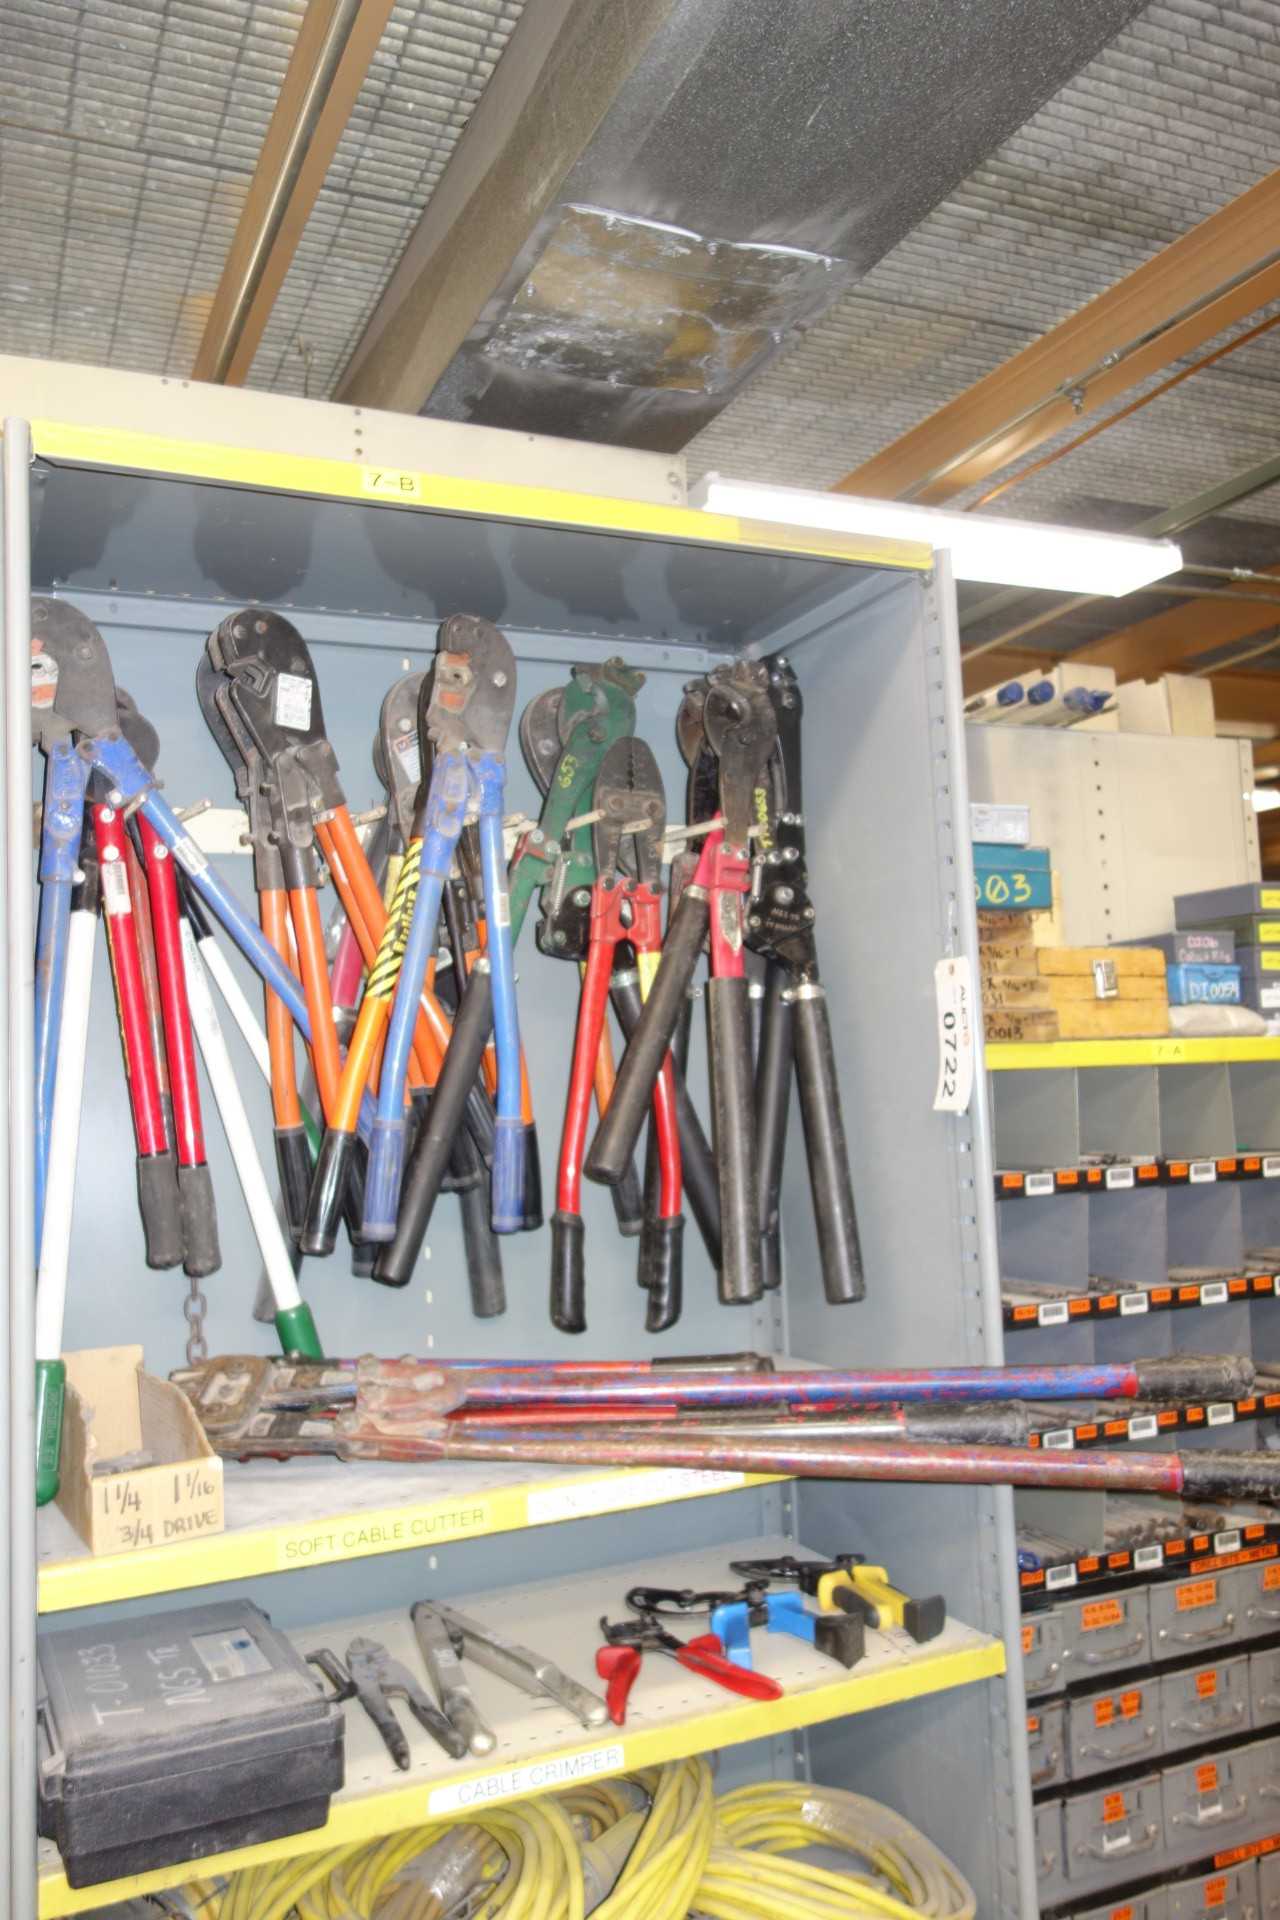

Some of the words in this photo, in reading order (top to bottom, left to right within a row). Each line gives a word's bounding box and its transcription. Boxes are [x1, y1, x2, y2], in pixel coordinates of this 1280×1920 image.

[368, 472, 415, 492] 7-B
[942, 1011, 958, 1098] 0722
[163, 1509, 217, 1538] DRIVE
[285, 1534, 336, 1559] SOFT
[342, 1522, 404, 1548] CABLE
[410, 1508, 485, 1535] CUTTER
[457, 1771, 521, 1804] CABLE
[529, 1747, 620, 1786] CRIMPER
